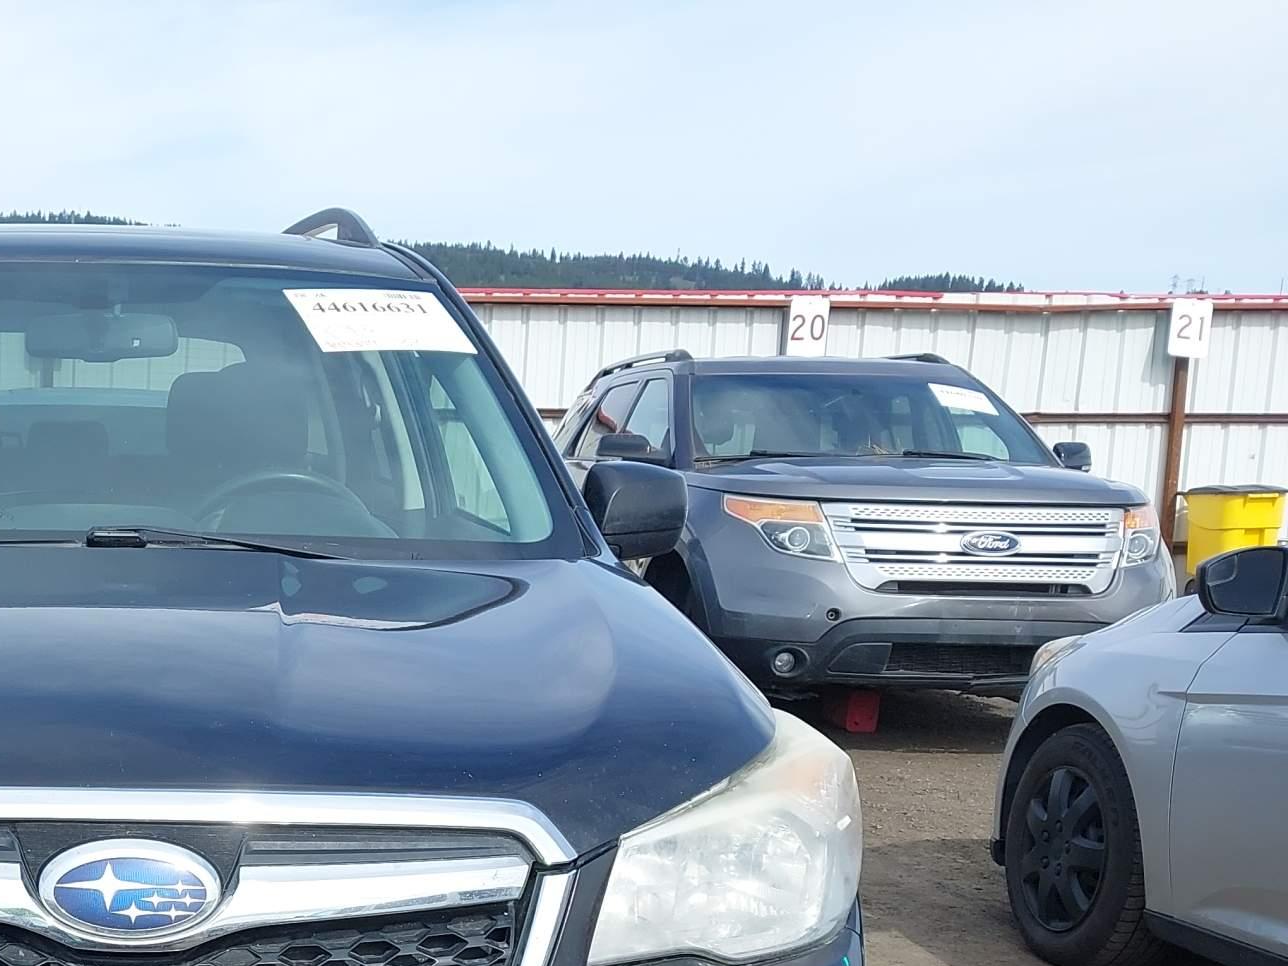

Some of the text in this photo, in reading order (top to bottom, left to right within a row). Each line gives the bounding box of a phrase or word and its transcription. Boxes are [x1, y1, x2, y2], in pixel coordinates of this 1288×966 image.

[312, 301, 428, 314] 44616631
[790, 315, 825, 341] 20
[1177, 314, 1205, 341] 21
